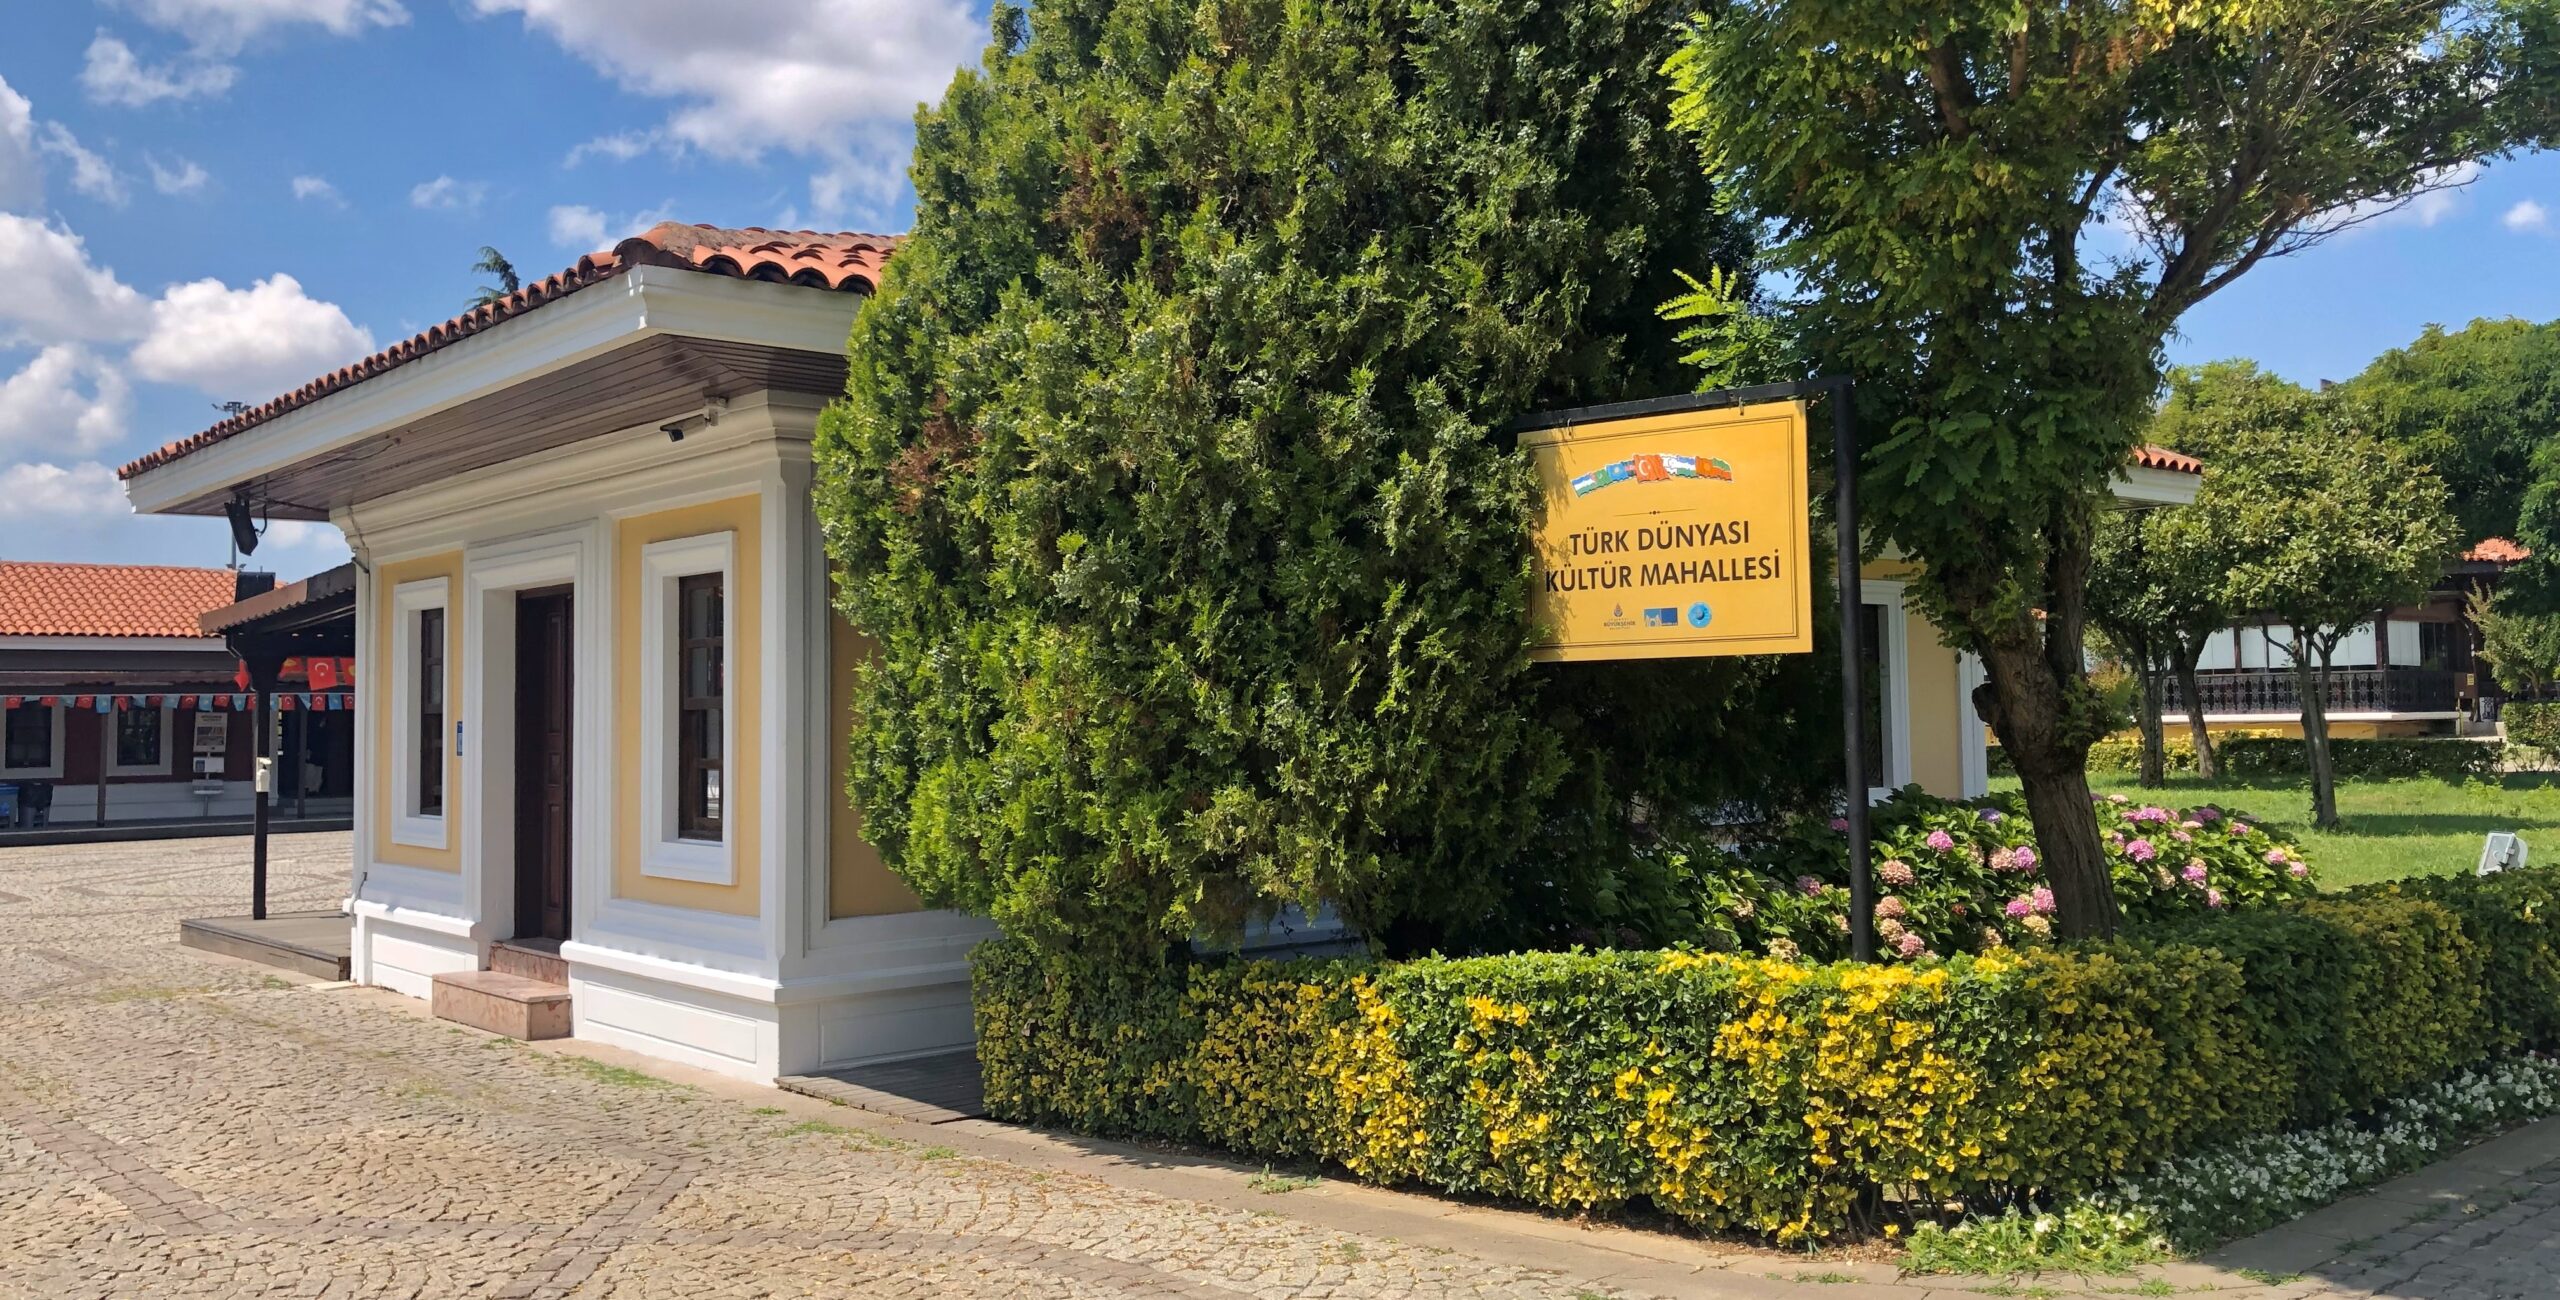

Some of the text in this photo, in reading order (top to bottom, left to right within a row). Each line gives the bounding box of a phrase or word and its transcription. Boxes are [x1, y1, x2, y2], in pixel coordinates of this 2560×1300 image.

[1569, 520, 1750, 556] TÜRK DÜNYASI
[1545, 548, 1780, 593] KÜLTÜR MAHALLESİ
